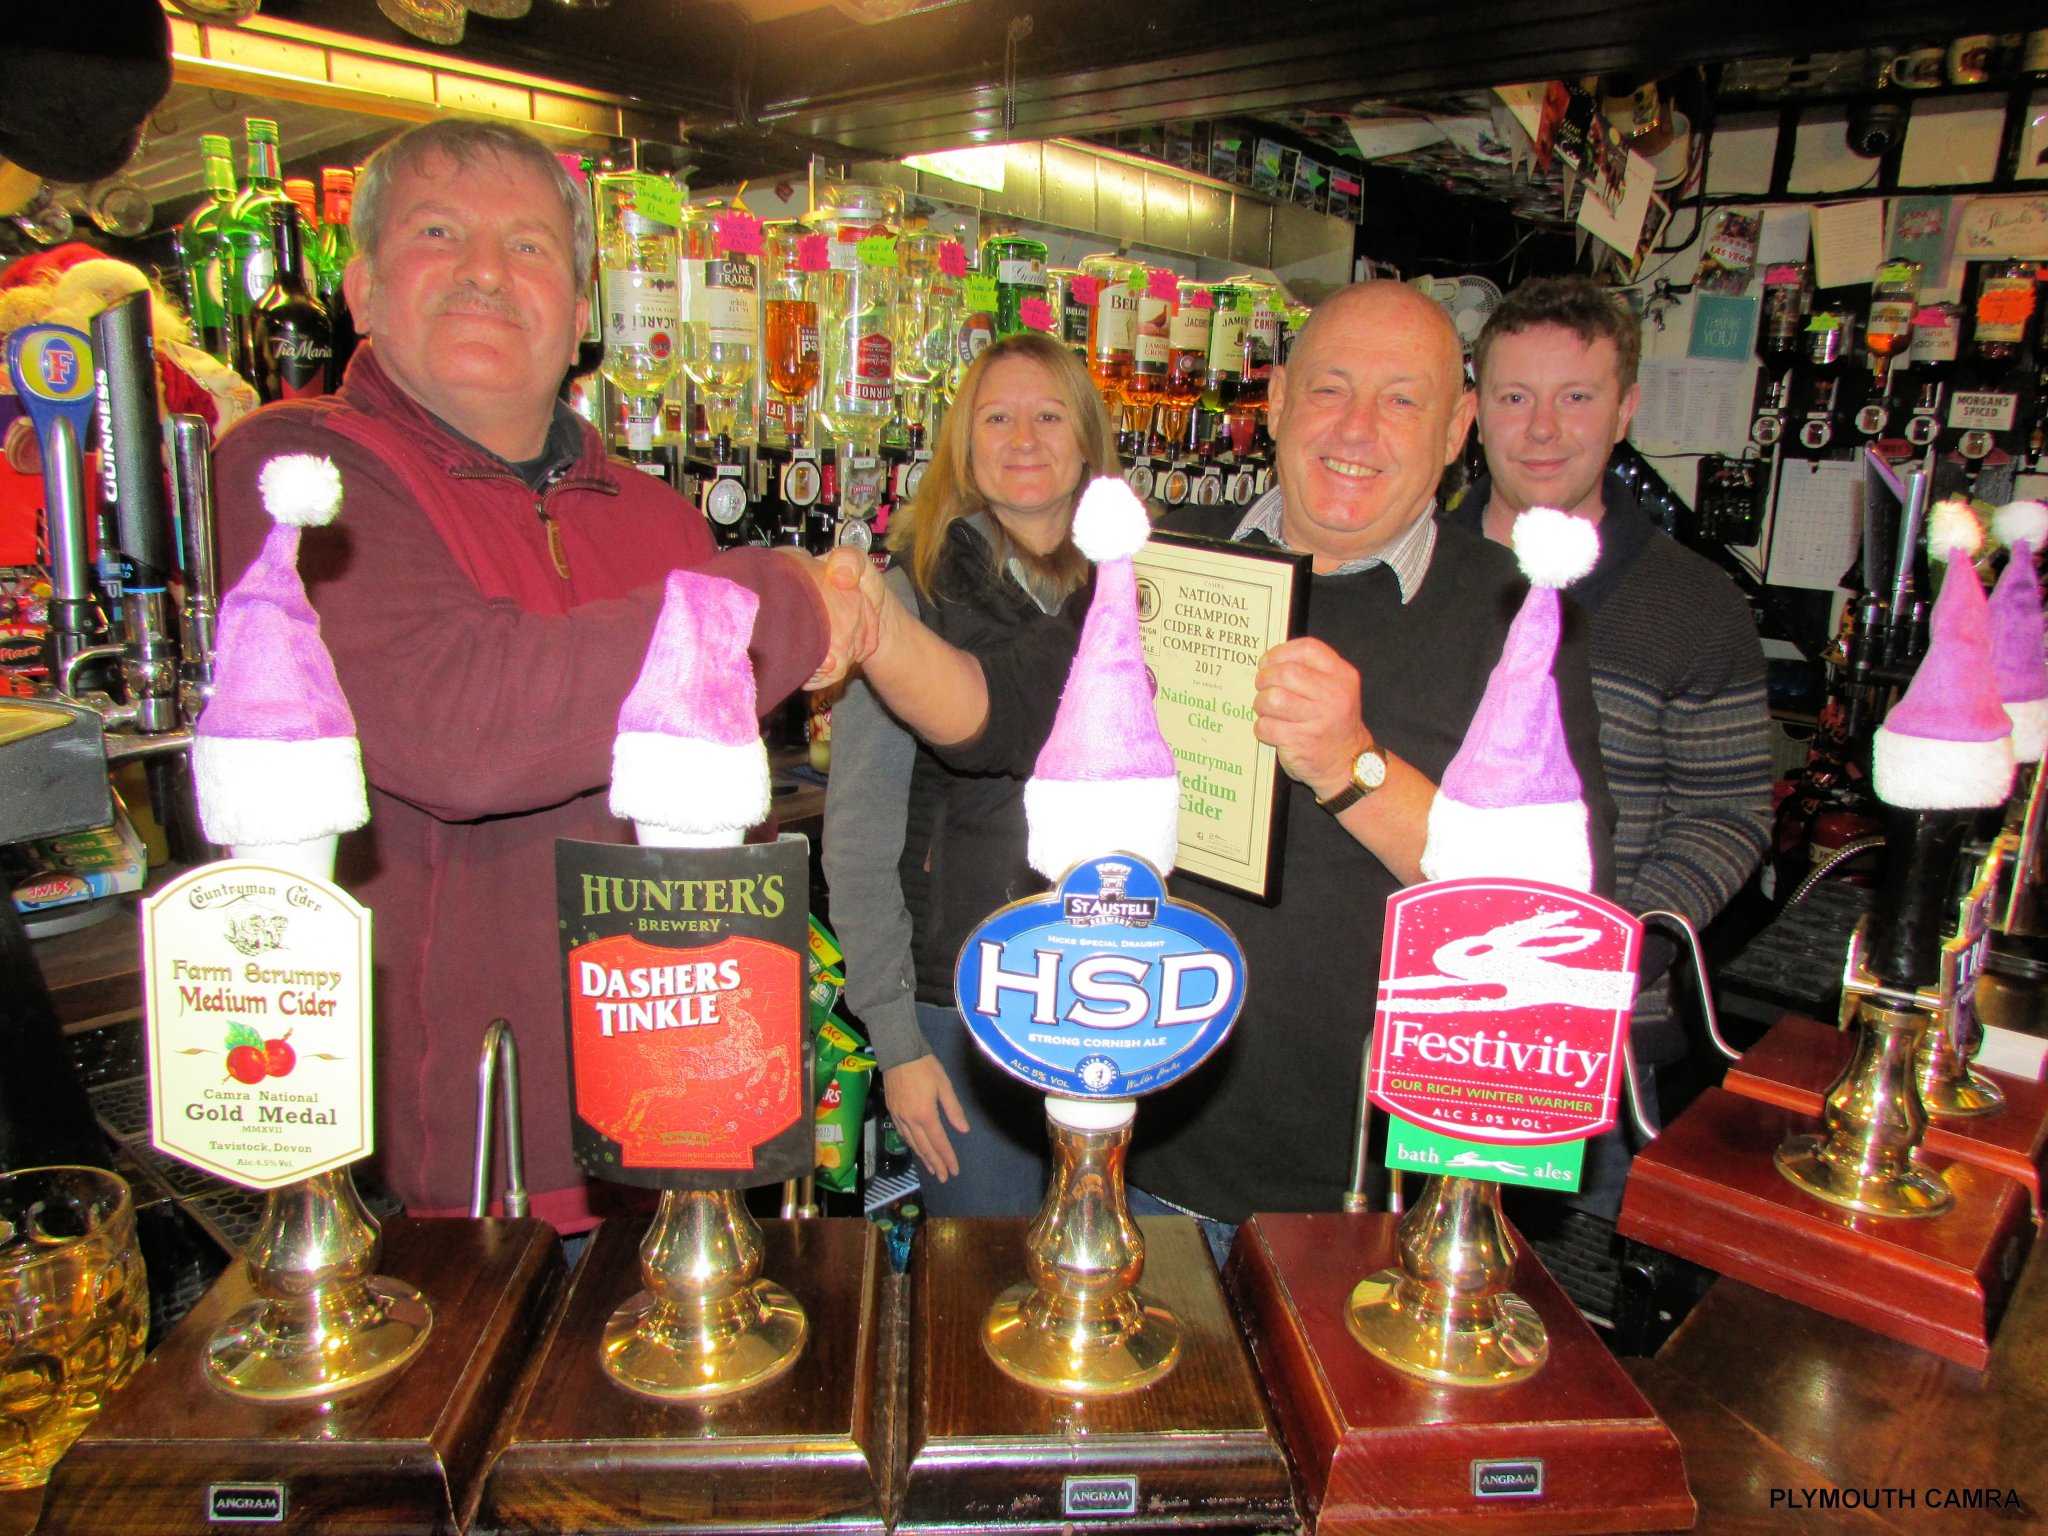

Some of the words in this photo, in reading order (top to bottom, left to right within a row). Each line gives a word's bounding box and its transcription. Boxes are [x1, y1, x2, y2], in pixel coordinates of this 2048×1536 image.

[1710, 246, 1726, 257] LAS
[1728, 251, 1754, 264] VEGA
[722, 262, 751, 275] CANE
[717, 273, 755, 289] TRADER
[269, 337, 296, 359] Tia
[295, 340, 333, 360] Maria
[801, 340, 818, 356] ed
[45, 349, 74, 384] F
[1956, 395, 2010, 407] MORGAN'S
[1962, 406, 1999, 417] SPICED
[95, 367, 118, 503] GUINNESS
[1179, 585, 1248, 611] NATIONAL
[1174, 603, 1250, 629] CHAMPION
[1138, 626, 1157, 635] PAIGN
[1163, 618, 1202, 638] CIDER
[1205, 627, 1215, 641] &
[1219, 629, 1260, 650] PERRY
[1162, 635, 1259, 667] COMPETITION
[1195, 660, 1223, 677] 2017
[1159, 685, 1217, 713] National
[1221, 701, 1255, 722] Gold
[1187, 712, 1224, 734] Cider
[28, 880, 71, 898] TWIX
[189, 883, 277, 910] Countryman
[285, 884, 323, 913] Cider
[580, 872, 786, 918] HUNTER'S
[638, 917, 721, 933] BREWERY
[1089, 916, 1131, 928] BREWERY
[1048, 935, 1077, 945] HICKS
[1079, 937, 1119, 948] SPECIAL
[1121, 940, 1166, 948] DRAUGHT
[171, 959, 233, 982] Farm
[244, 961, 343, 992] Scrumpy
[579, 958, 743, 1000] DASHERS
[974, 939, 1236, 1031] HSD
[178, 985, 268, 1017] Medium
[278, 990, 338, 1018] Cider
[595, 993, 722, 1038] TINKLE
[1027, 1033, 1081, 1047] STRONG
[1083, 1036, 1142, 1048] CORNISH
[1143, 1036, 1168, 1047] ALE
[1389, 1019, 1608, 1089] Festivity
[1010, 1058, 1029, 1073] ALC
[1031, 1067, 1047, 1082] 5%
[1049, 1075, 1070, 1089] VOL
[203, 1088, 251, 1101] Camra
[259, 1090, 319, 1103] National
[1390, 1077, 1423, 1092] OUR
[1426, 1082, 1462, 1098] RICH
[1466, 1087, 1525, 1106] WINTER
[1528, 1095, 1594, 1114] WARMER
[185, 1103, 245, 1122] Gold
[258, 1105, 338, 1126] Medal
[1432, 1107, 1463, 1121] ALC
[1470, 1111, 1505, 1126] 5.0%
[1511, 1116, 1542, 1130] VOL
[241, 1124, 283, 1134] MMXVII
[209, 1140, 272, 1153] Tavistock,
[273, 1142, 313, 1153] Devon
[1397, 1143, 1441, 1165] bath
[1533, 1161, 1573, 1182] ales
[1481, 1473, 1536, 1485] ANGRAM
[215, 1497, 278, 1509] ANGRAM
[1072, 1490, 1129, 1502] ANGRAM
